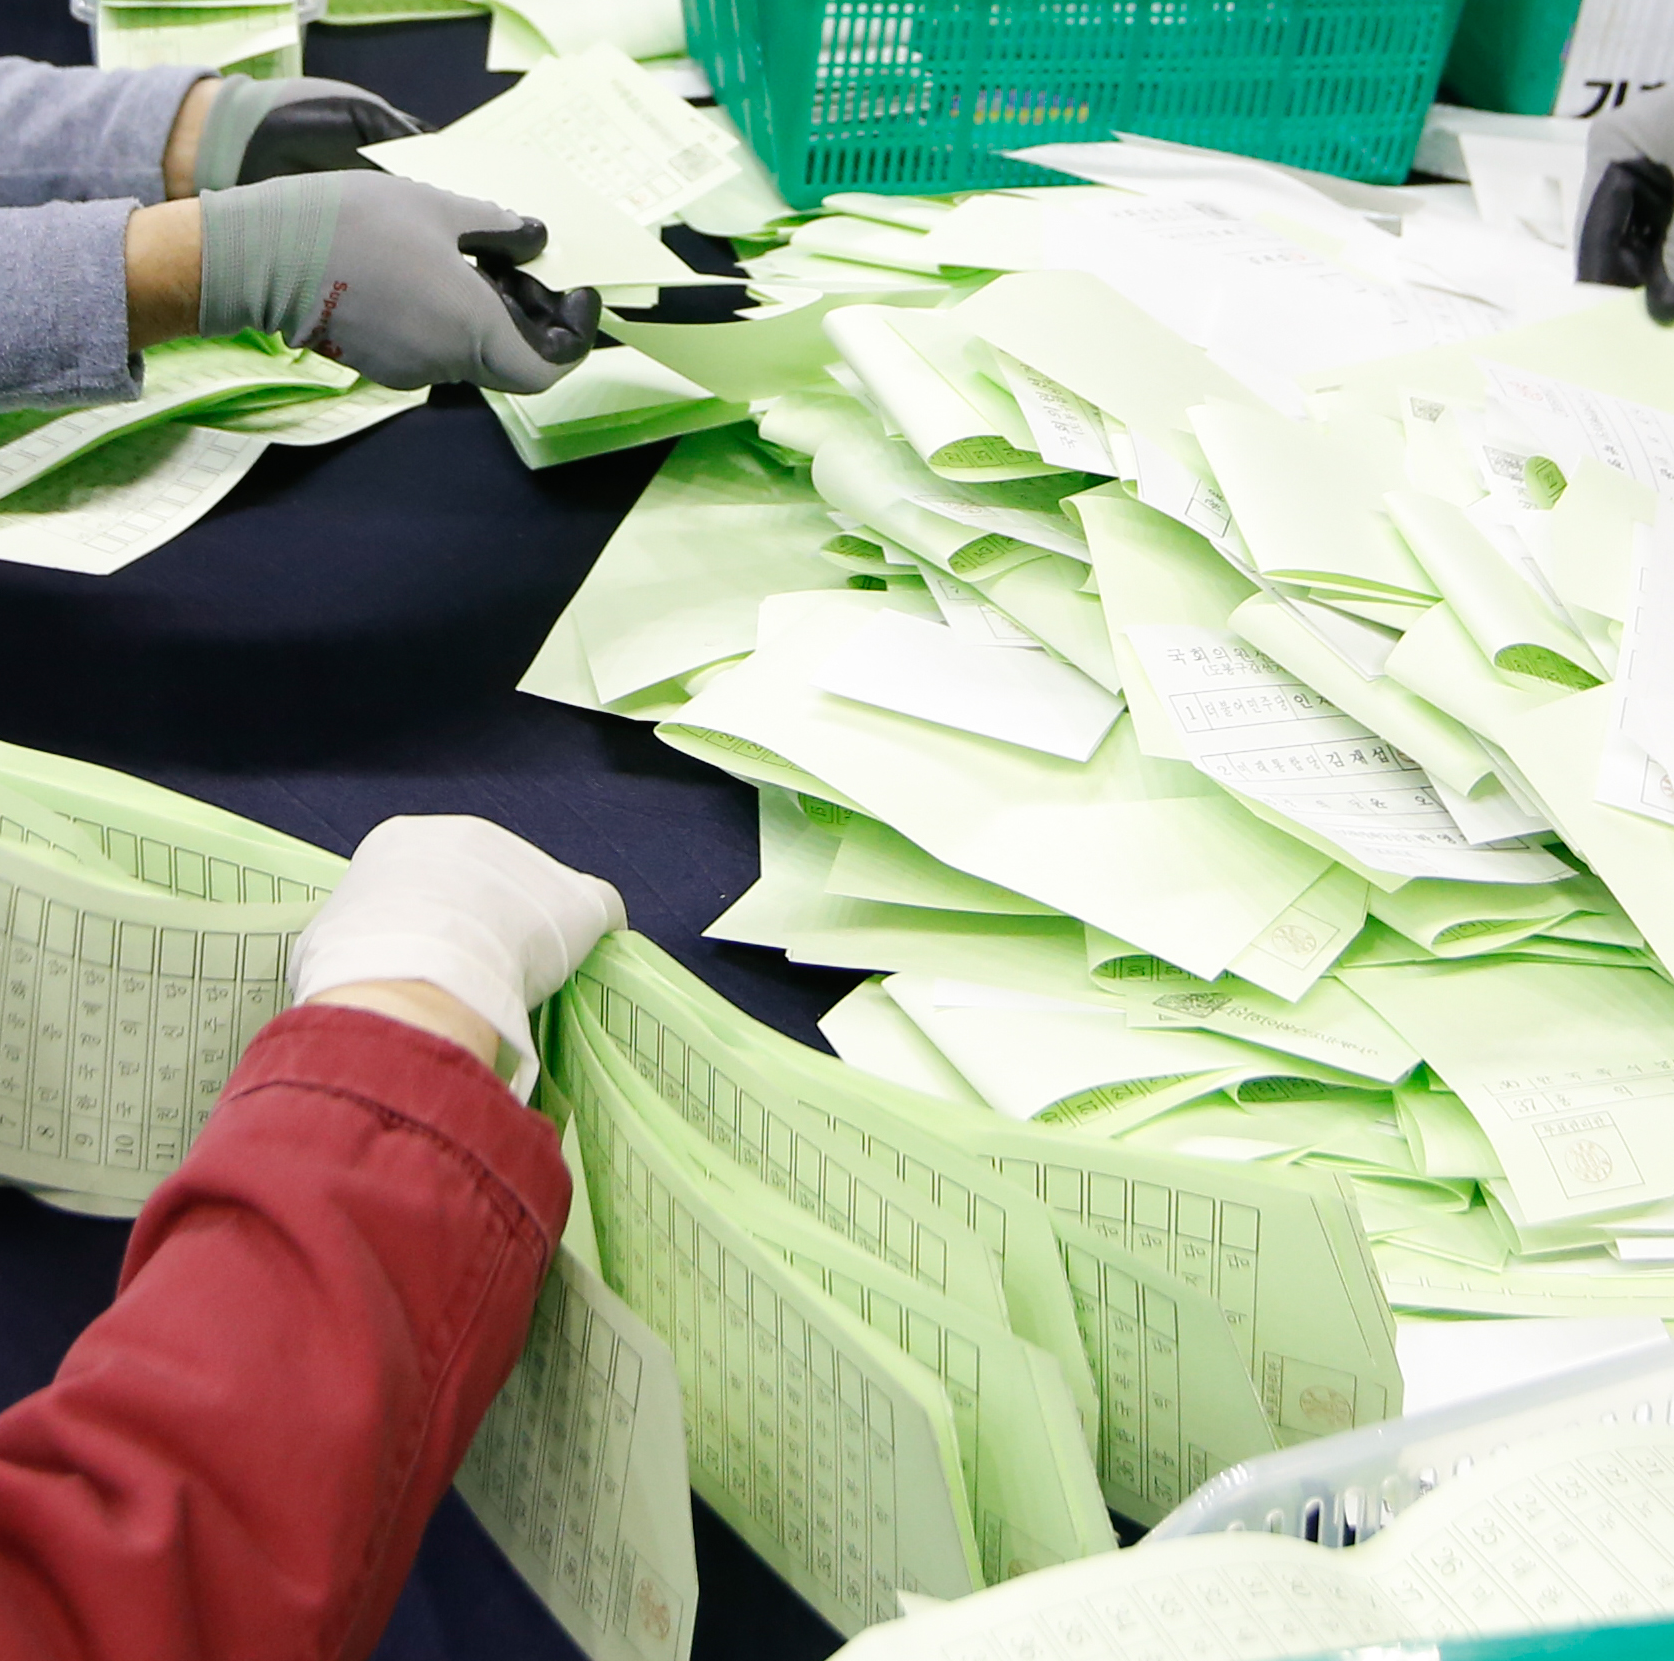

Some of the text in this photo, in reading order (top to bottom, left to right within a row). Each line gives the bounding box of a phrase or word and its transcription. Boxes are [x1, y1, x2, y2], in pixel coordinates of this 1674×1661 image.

[320, 279, 349, 325] Super
[1186, 705, 1196, 721] 1
[1204, 694, 1288, 719] 더불어민주당
[1216, 745, 1393, 777] 2 미래통합당 김재섭
[0, 947, 33, 1129] 7 우리공화당
[36, 959, 68, 1139] 8 민중당
[74, 968, 105, 1147] 9 한국경제당
[114, 977, 145, 1156] 10 국민의당
[155, 981, 187, 1161] 11 친박신당
[1512, 1097, 1538, 1115] 37
[1112, 1313, 1135, 1483] 36 한국복지당
[1153, 1475, 1173, 1503] 37
